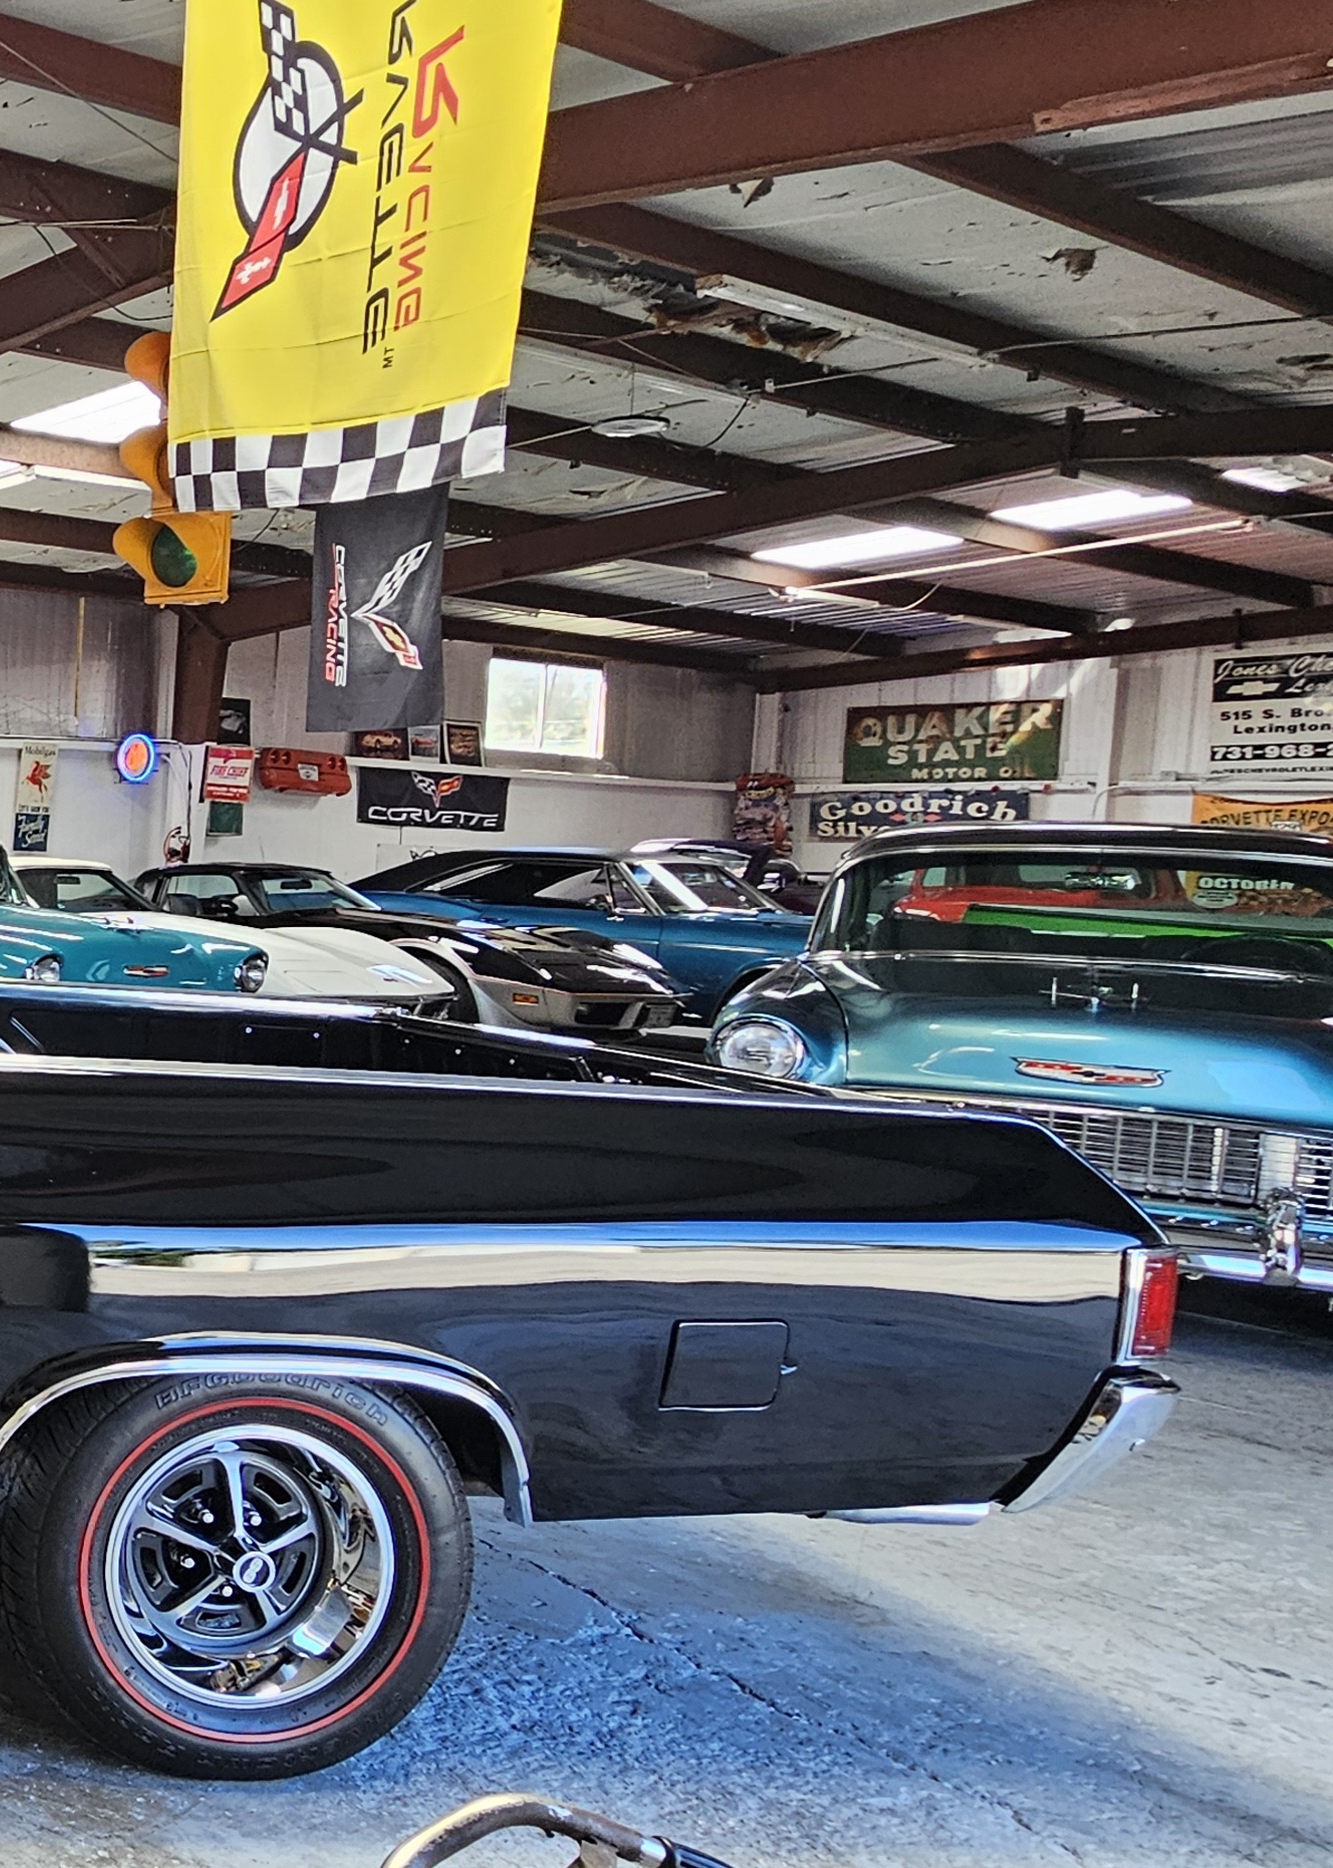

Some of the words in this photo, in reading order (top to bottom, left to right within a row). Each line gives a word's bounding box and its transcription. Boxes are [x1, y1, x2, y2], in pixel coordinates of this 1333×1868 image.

[1215, 660, 1280, 683] Jones
[854, 702, 1053, 747] QUAKER
[1220, 709, 1253, 722] 515
[1262, 709, 1281, 719] S.
[887, 737, 1008, 765] STATE
[911, 766, 987, 780] MOTOR
[368, 806, 499, 828] CORVETTE
[820, 794, 1017, 822] Goodrich
